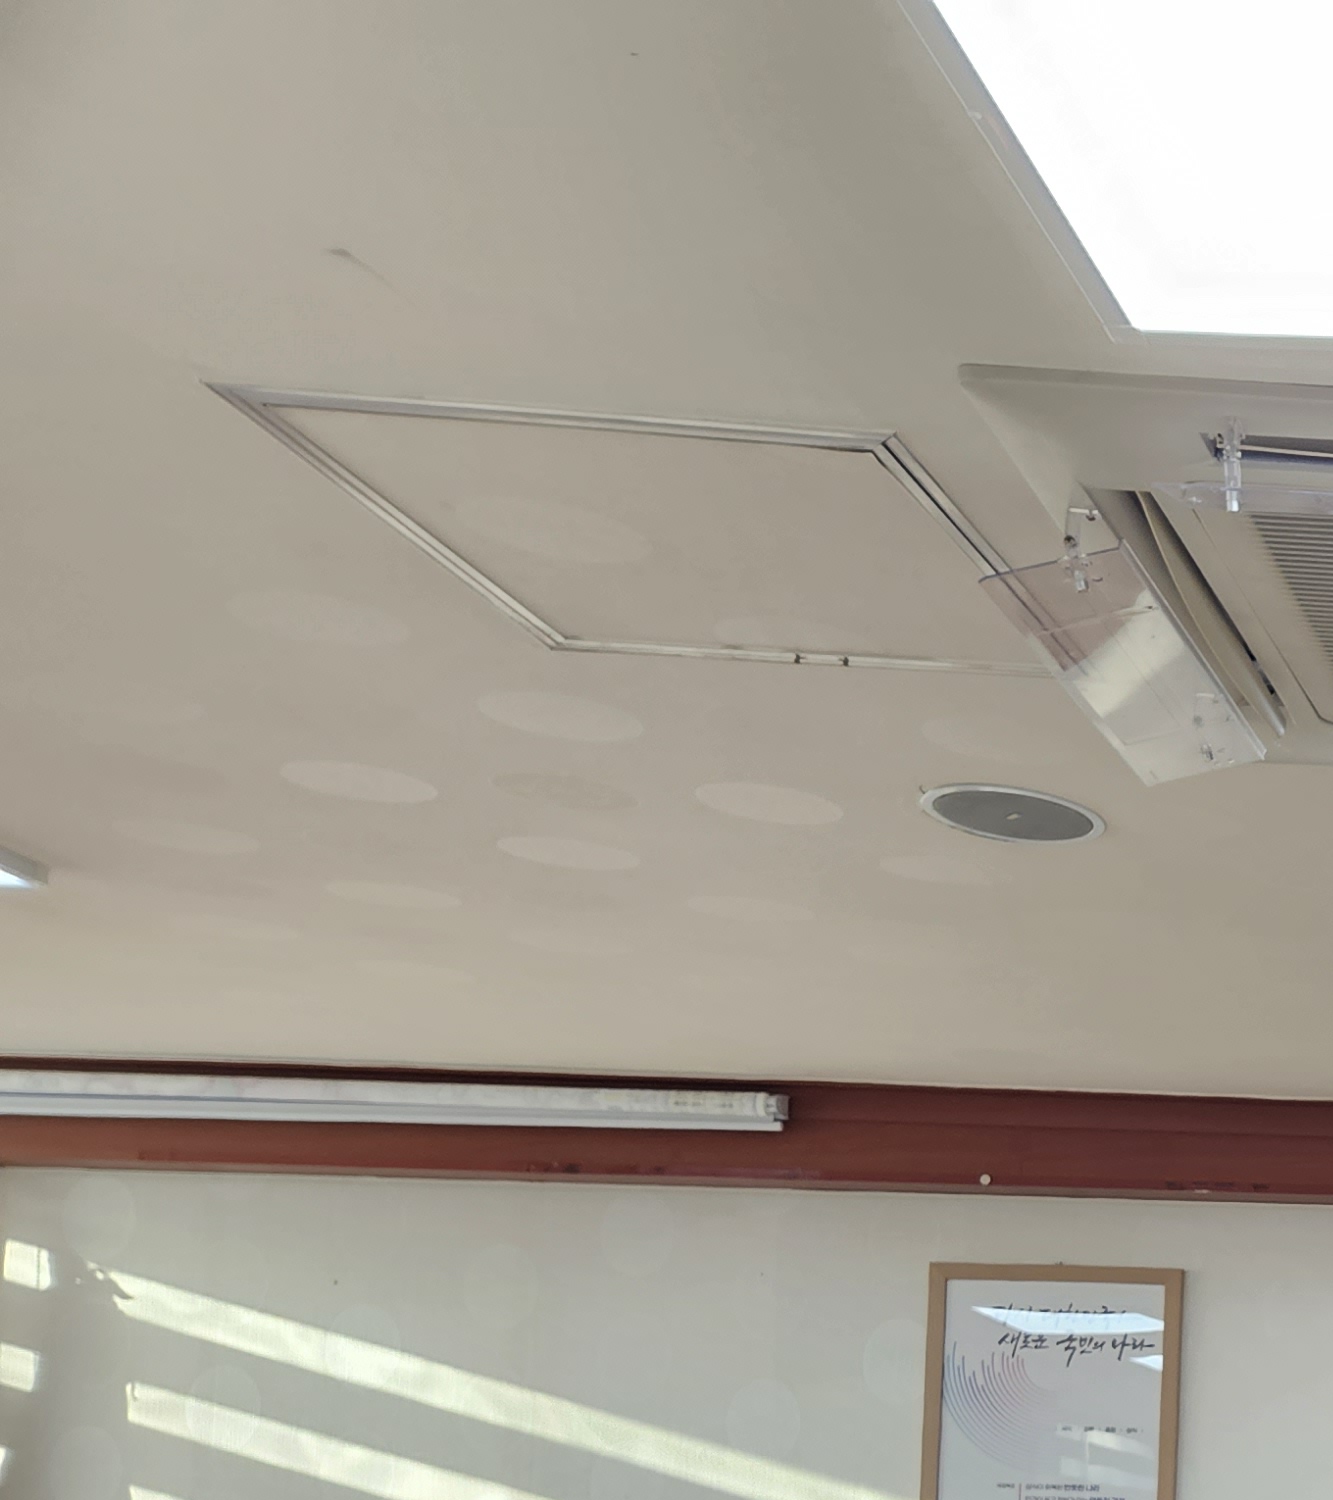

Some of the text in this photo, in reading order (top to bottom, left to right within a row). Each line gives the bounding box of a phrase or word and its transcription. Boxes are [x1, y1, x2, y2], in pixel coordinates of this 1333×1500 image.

[998, 1331, 1156, 1368] 새로운 국민의 나라
